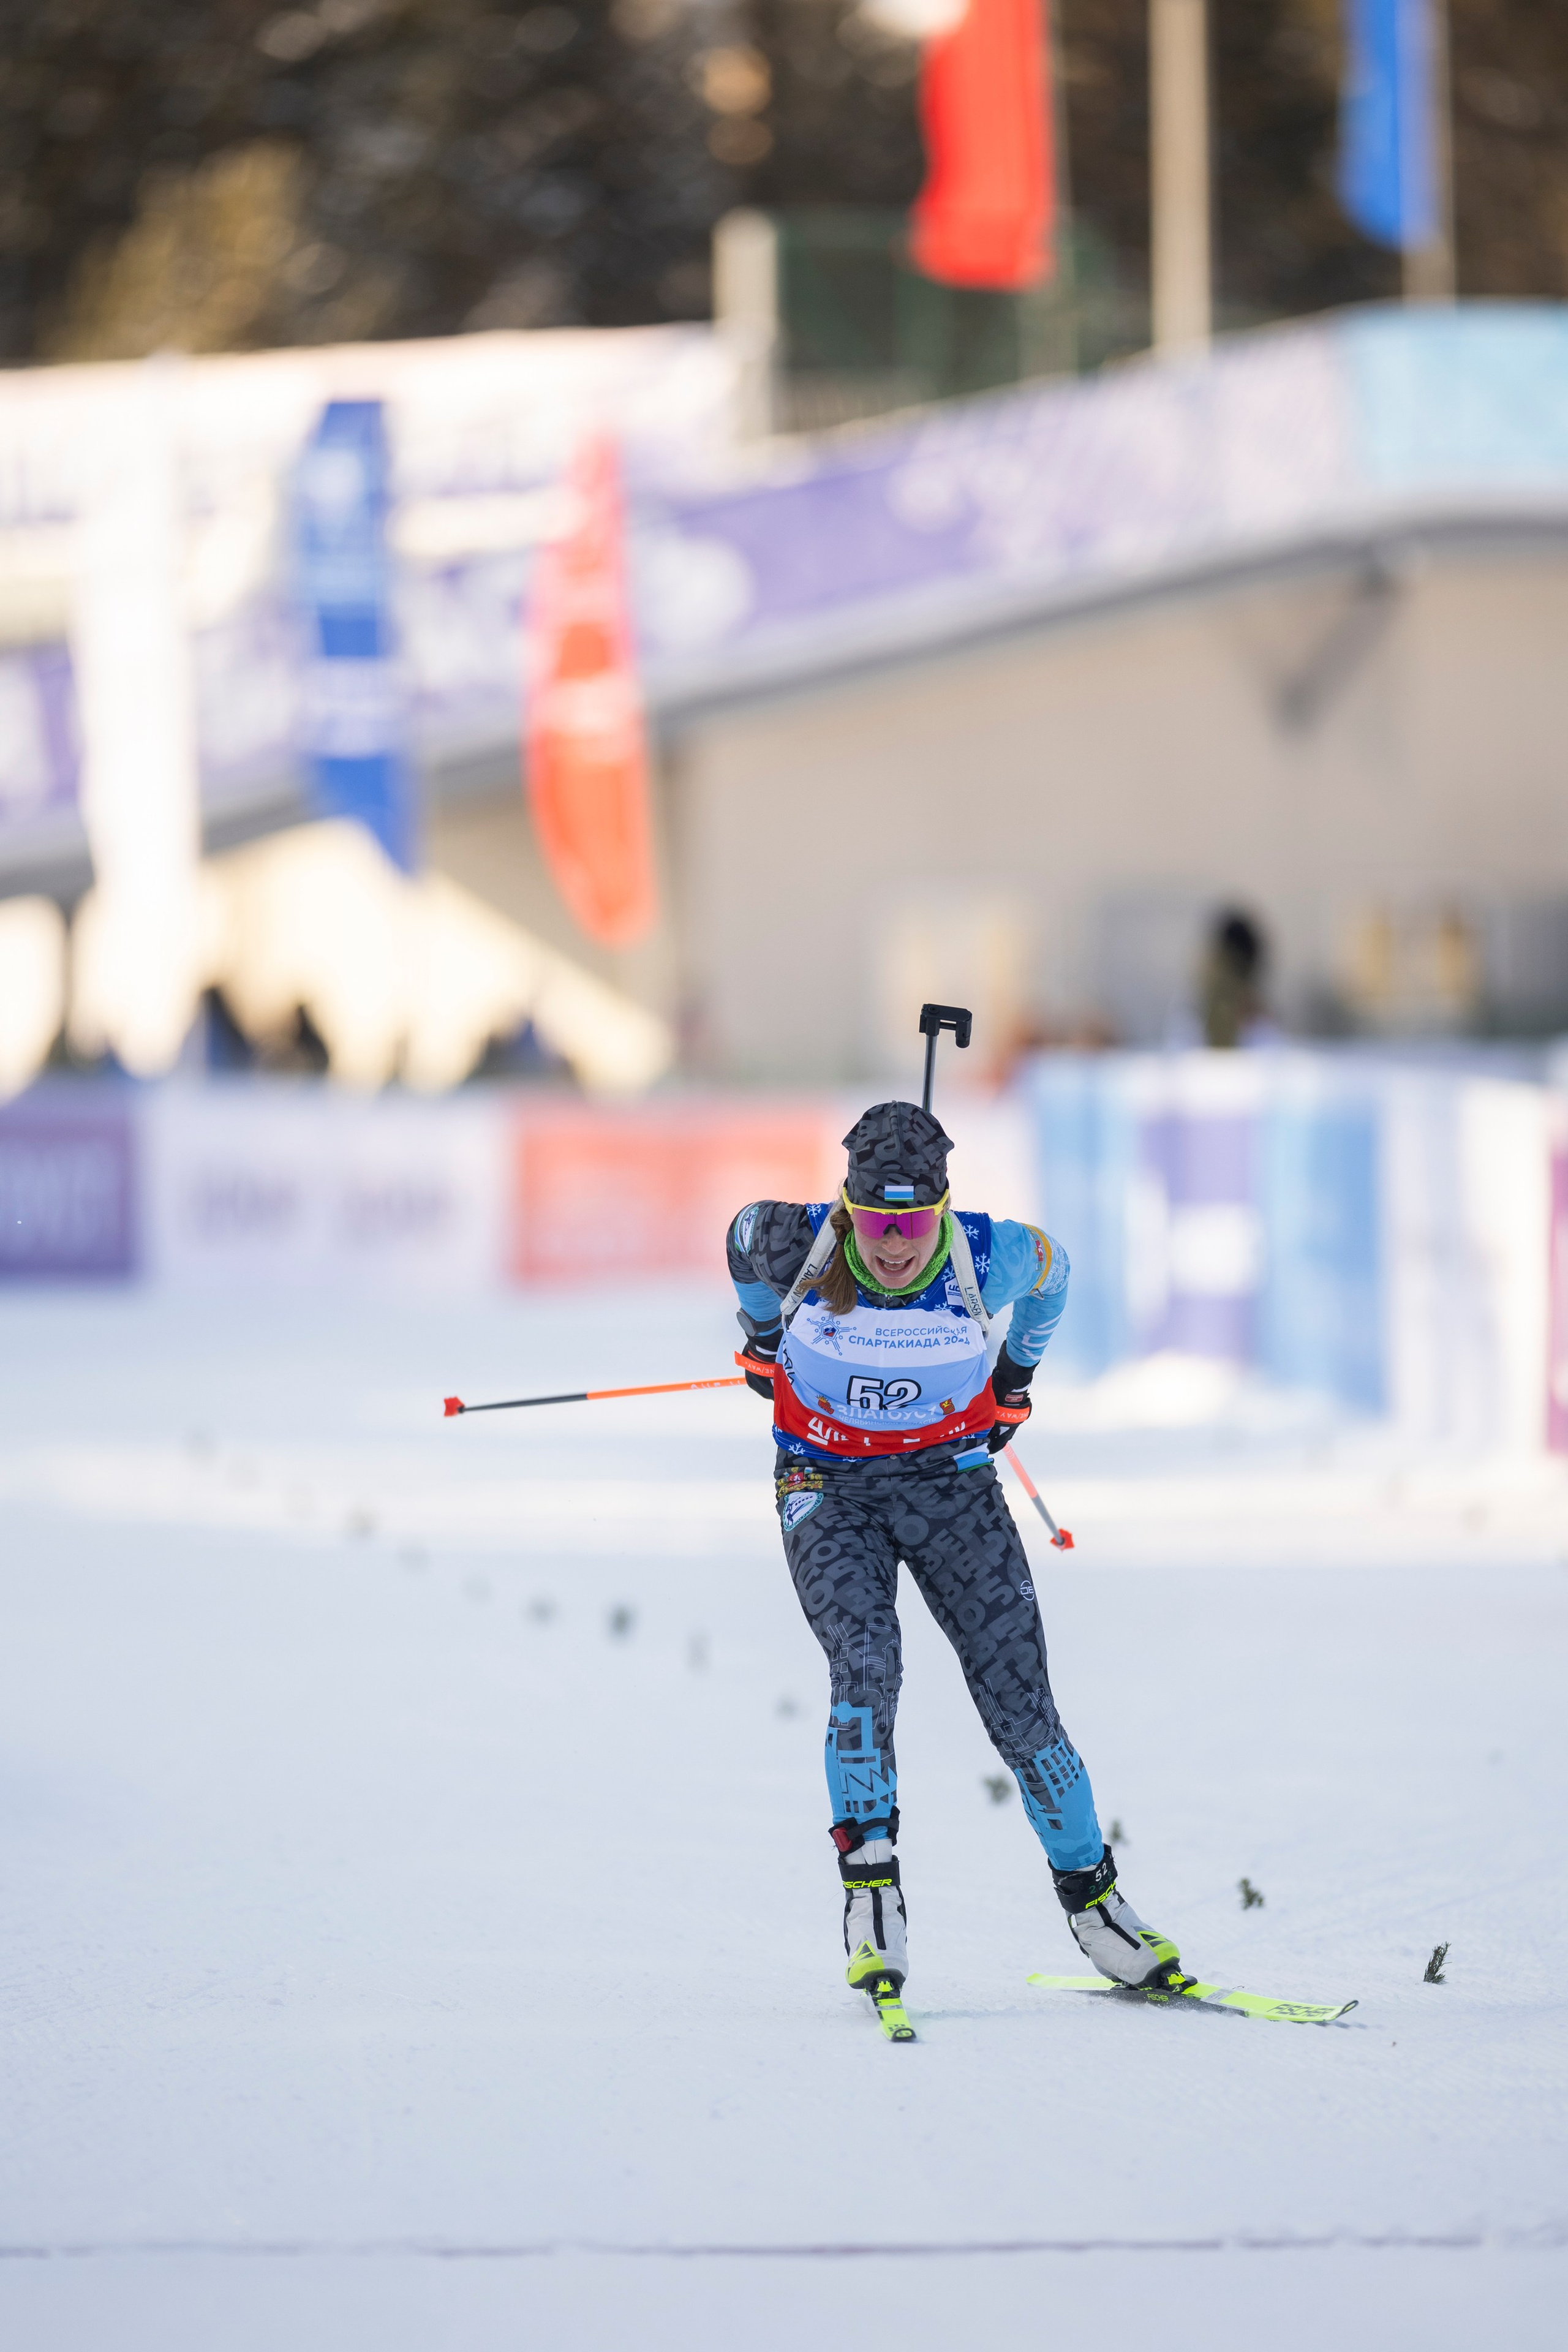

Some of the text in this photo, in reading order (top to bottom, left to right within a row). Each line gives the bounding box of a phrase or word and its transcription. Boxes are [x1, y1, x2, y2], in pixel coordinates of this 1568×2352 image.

[793, 1263, 818, 1298] LAREN
[965, 1286, 983, 1316] LARSEN
[875, 1325, 967, 1336] ВСЕРОССИЙСКАЯ
[848, 1335, 941, 1349] СПАРТАКИАДА
[846, 1375, 922, 1411] 52
[1095, 1863, 1108, 1882] 52
[1267, 2003, 1336, 2018] FISCHER
